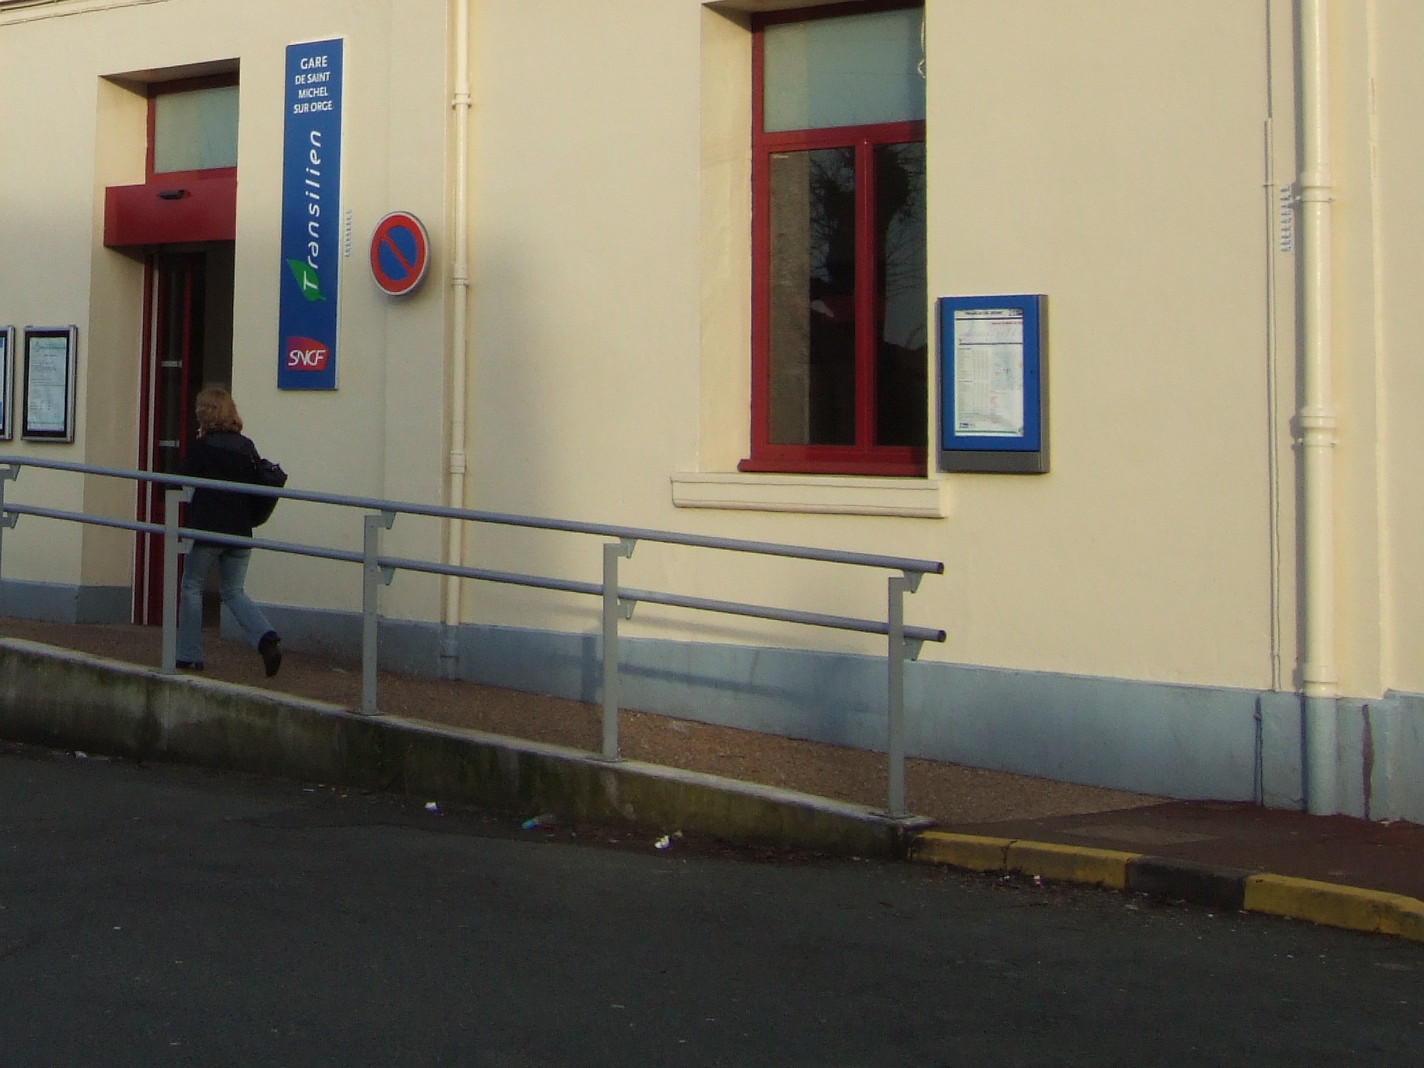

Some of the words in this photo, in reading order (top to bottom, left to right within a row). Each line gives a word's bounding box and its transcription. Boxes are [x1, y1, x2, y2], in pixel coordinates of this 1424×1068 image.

[300, 55, 328, 70] GARE
[295, 74, 306, 85] DE
[307, 71, 331, 84] SAINT
[298, 86, 328, 99] MICHEL
[293, 103, 309, 115] SUR
[310, 100, 333, 112] ORGE
[303, 131, 322, 292] Transilien
[287, 349, 326, 366] SNCF
